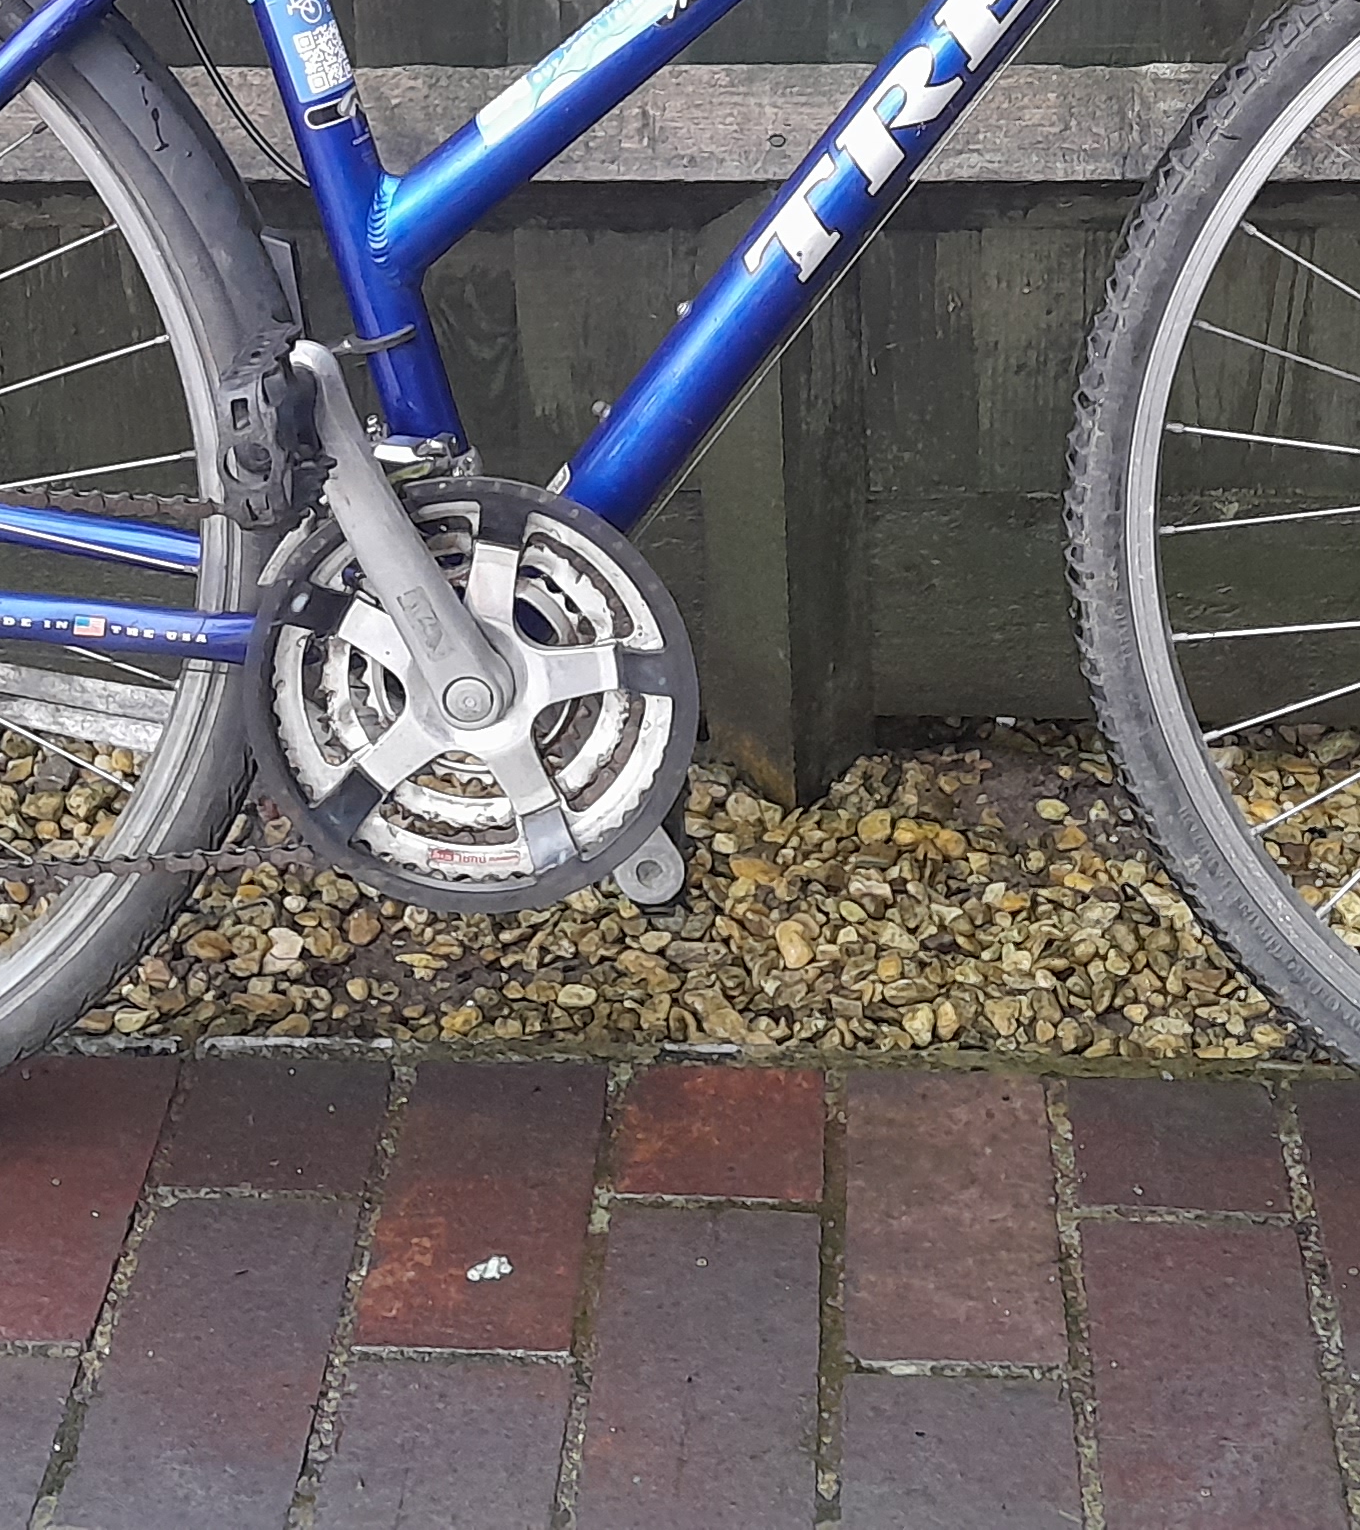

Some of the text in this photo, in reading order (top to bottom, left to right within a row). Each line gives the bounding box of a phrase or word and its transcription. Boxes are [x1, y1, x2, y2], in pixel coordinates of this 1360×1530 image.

[43, 619, 69, 630] IN
[110, 624, 155, 641] THE
[166, 631, 208, 644] USA
